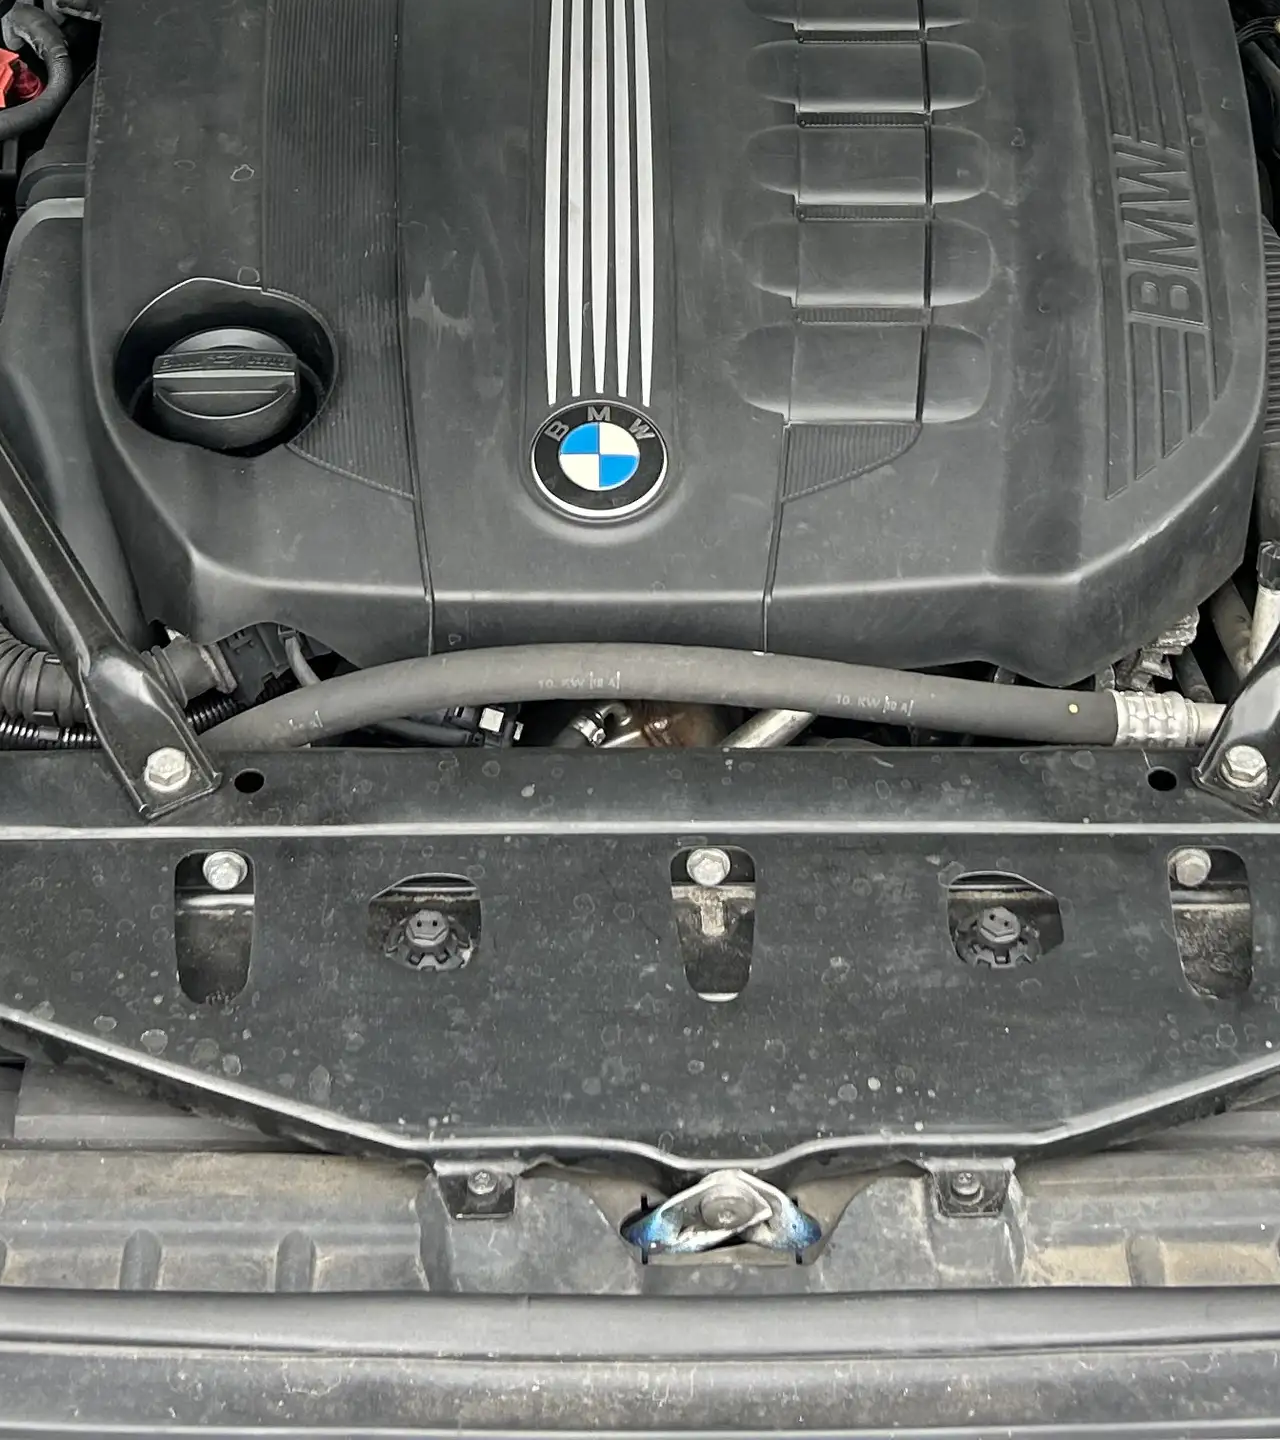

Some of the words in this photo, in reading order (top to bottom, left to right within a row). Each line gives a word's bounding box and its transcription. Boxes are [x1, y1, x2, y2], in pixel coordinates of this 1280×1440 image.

[1111, 132, 1209, 328] BMW
[543, 406, 656, 442] BMW
[857, 695, 881, 709] KW
